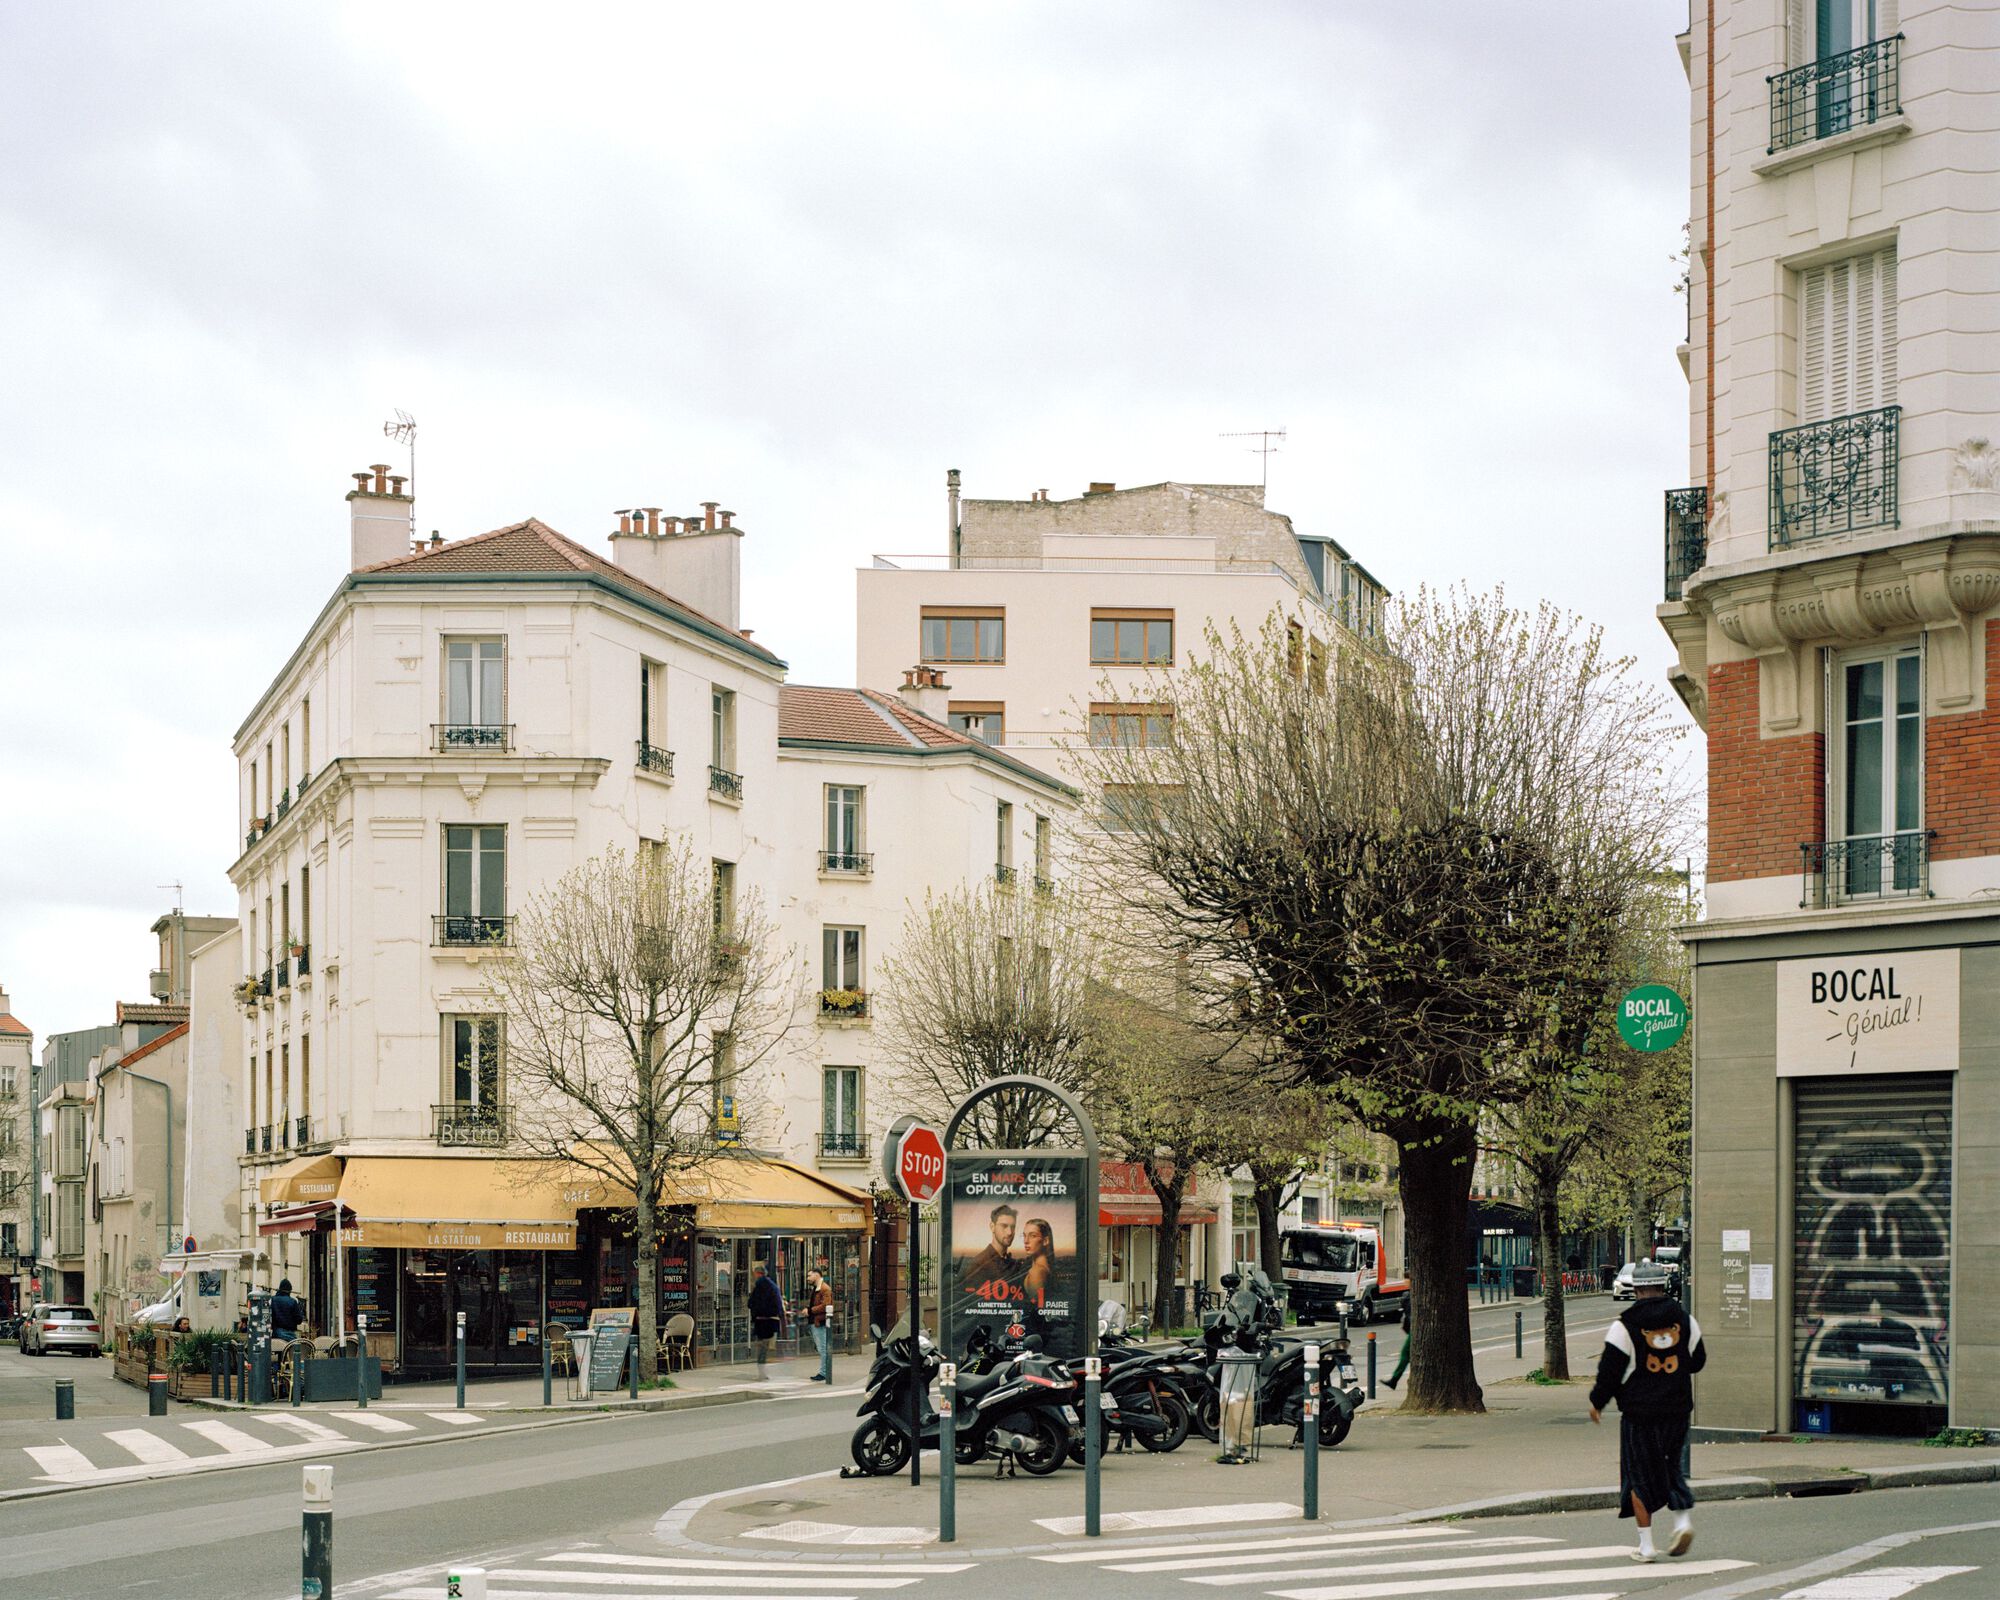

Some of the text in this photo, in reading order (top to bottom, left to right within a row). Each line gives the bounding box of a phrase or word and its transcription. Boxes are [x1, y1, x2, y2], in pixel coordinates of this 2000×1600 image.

[1812, 967, 1901, 1004] BOCAL
[1625, 999, 1673, 1017] BOCAL
[1644, 1013, 1679, 1037] Génial
[1846, 996, 1912, 1045] Génial
[442, 1124, 499, 1145] Bistro
[904, 1150, 941, 1177] STOP
[972, 1173, 1061, 1183] EN MARS CHEZ
[300, 1184, 335, 1194] RESTAURANT
[966, 1185, 1067, 1195] OPTICAL CENTER
[428, 1235, 480, 1245] LA STATION
[506, 1232, 570, 1244] RESTAURANT
[1723, 1259, 1742, 1267] BOCAL
[664, 1275, 682, 1283] PINTES
